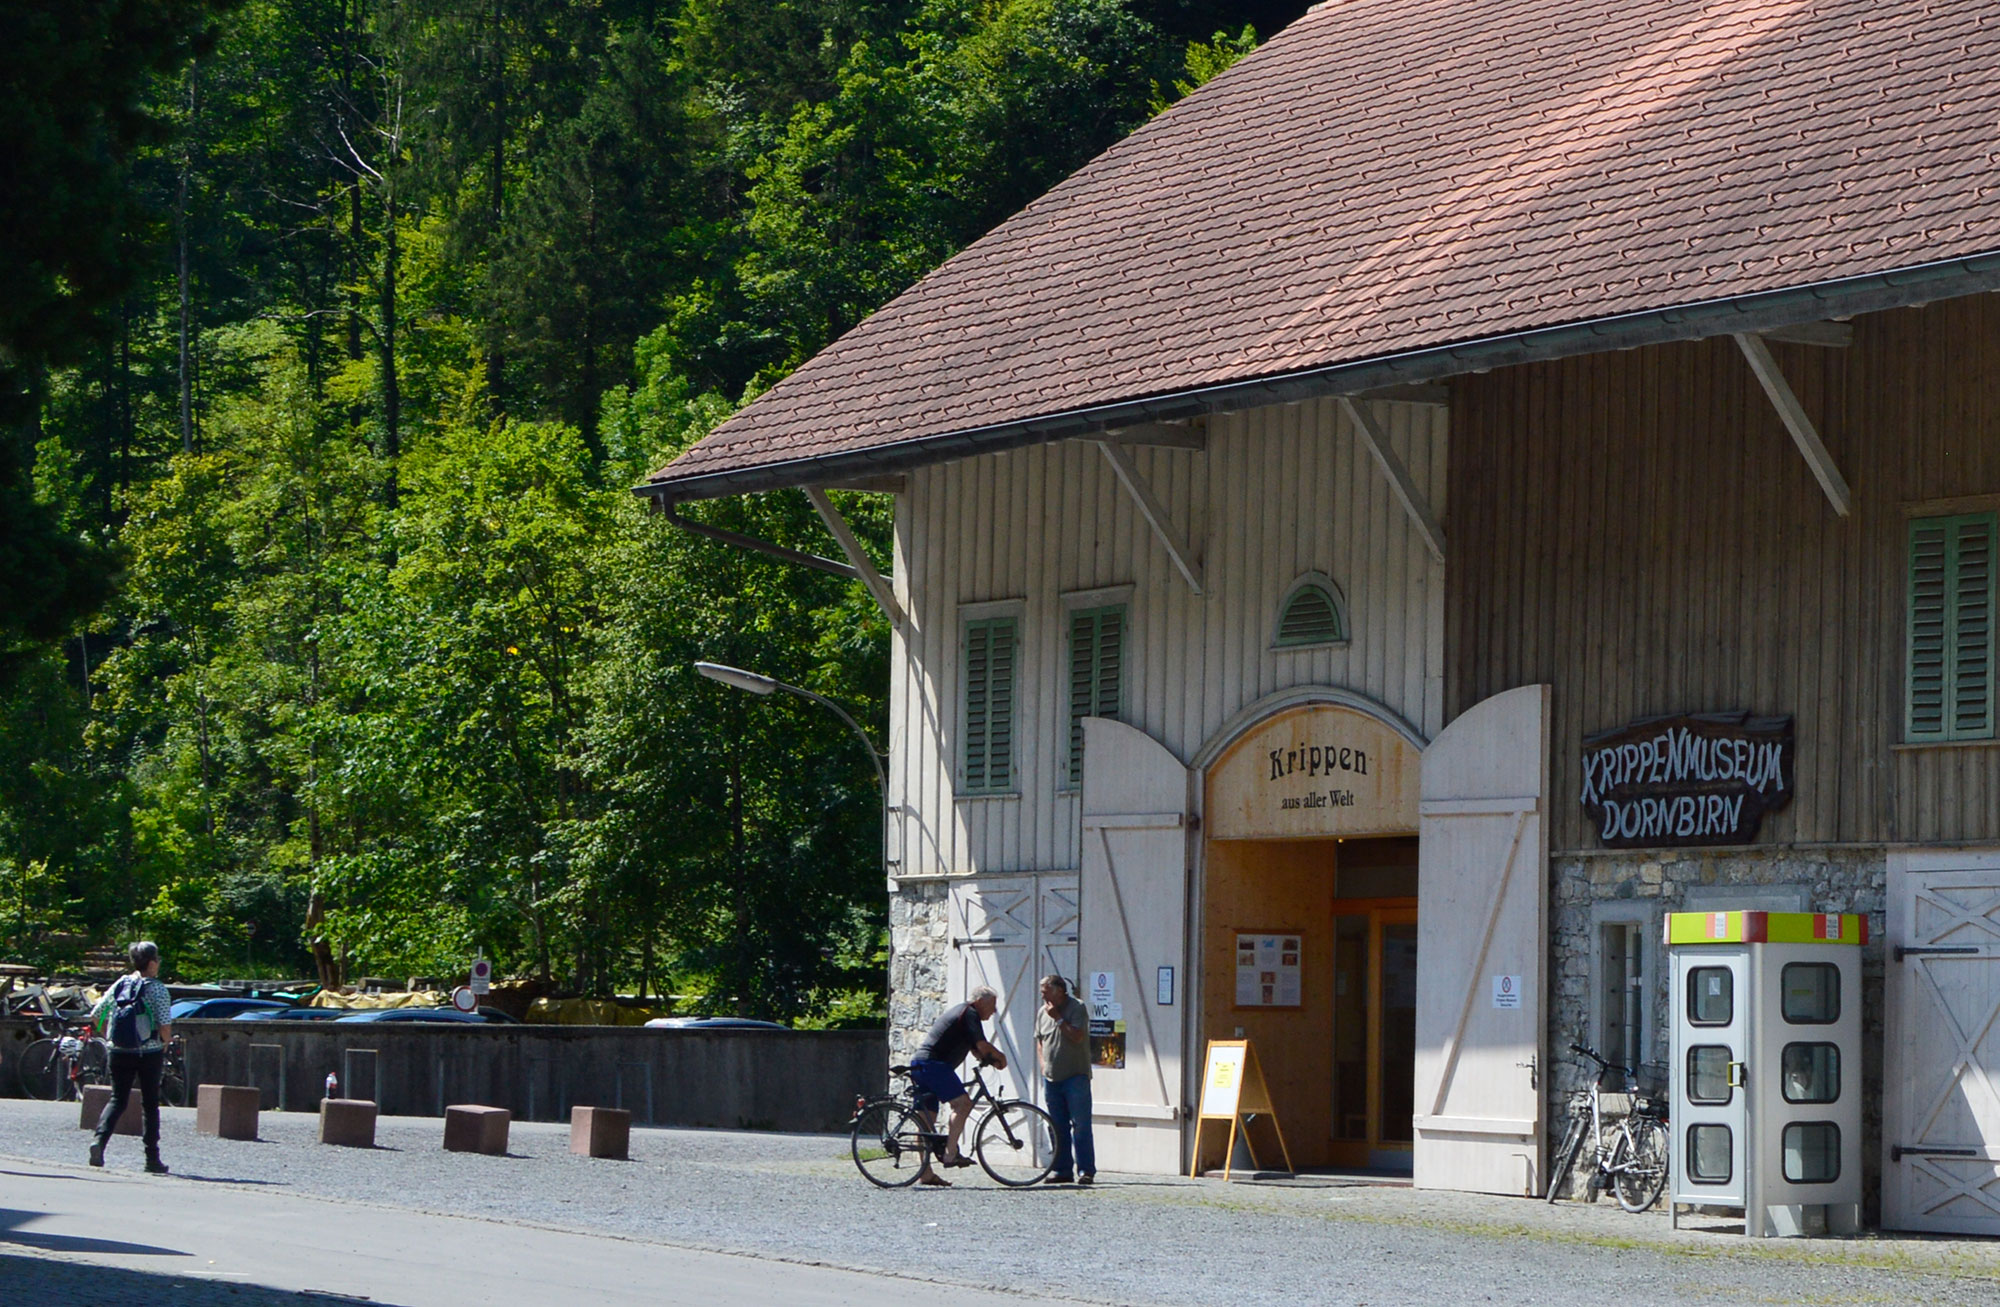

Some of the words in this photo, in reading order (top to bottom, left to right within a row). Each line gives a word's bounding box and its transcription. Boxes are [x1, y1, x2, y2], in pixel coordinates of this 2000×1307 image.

[1269, 742, 1367, 781] Krippen
[1580, 726, 1784, 805] KRIPPENMUSEUM
[1281, 798, 1300, 809] aus
[1303, 791, 1327, 808] aller
[1329, 789, 1354, 807] Welt
[1602, 793, 1744, 840] DORNBIRN
[1093, 1004, 1109, 1017] WC
